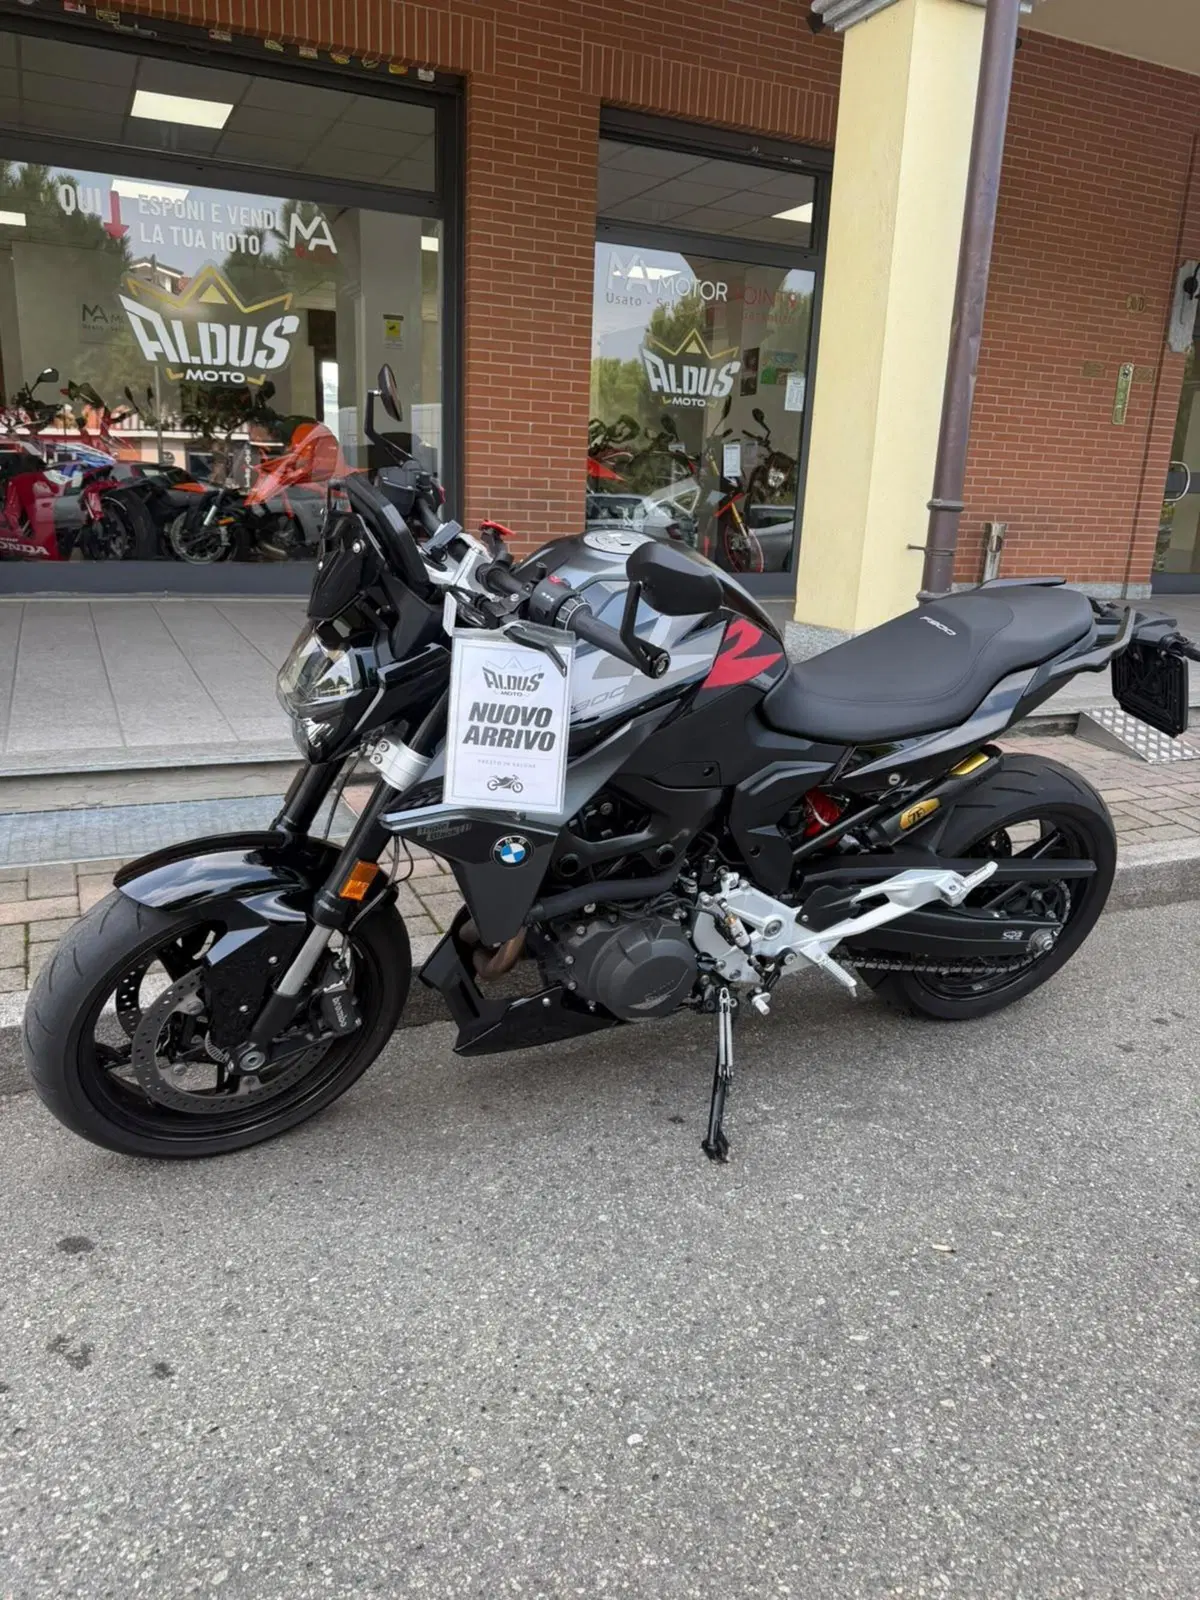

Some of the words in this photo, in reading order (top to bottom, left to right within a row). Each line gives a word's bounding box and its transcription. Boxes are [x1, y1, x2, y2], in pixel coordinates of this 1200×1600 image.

[58, 183, 102, 216] QUI
[138, 193, 205, 222] ESPONI
[212, 206, 222, 224] E
[226, 205, 282, 231] VENDI
[140, 222, 165, 245] LA
[170, 226, 207, 250] TUA
[211, 231, 260, 256] MOTO
[606, 292, 642, 306] Usato
[656, 275, 729, 302] MOTOR
[118, 293, 301, 370] ALDUS
[184, 368, 246, 385] MOTO
[640, 348, 742, 398] ALDUS
[672, 397, 706, 408] MOTO
[0, 542, 50, 556] ONDA
[482, 666, 545, 693] ALDUS
[468, 701, 553, 728] NUOVO
[462, 724, 557, 752] ARRIVO
[332, 996, 348, 1028] brembo
